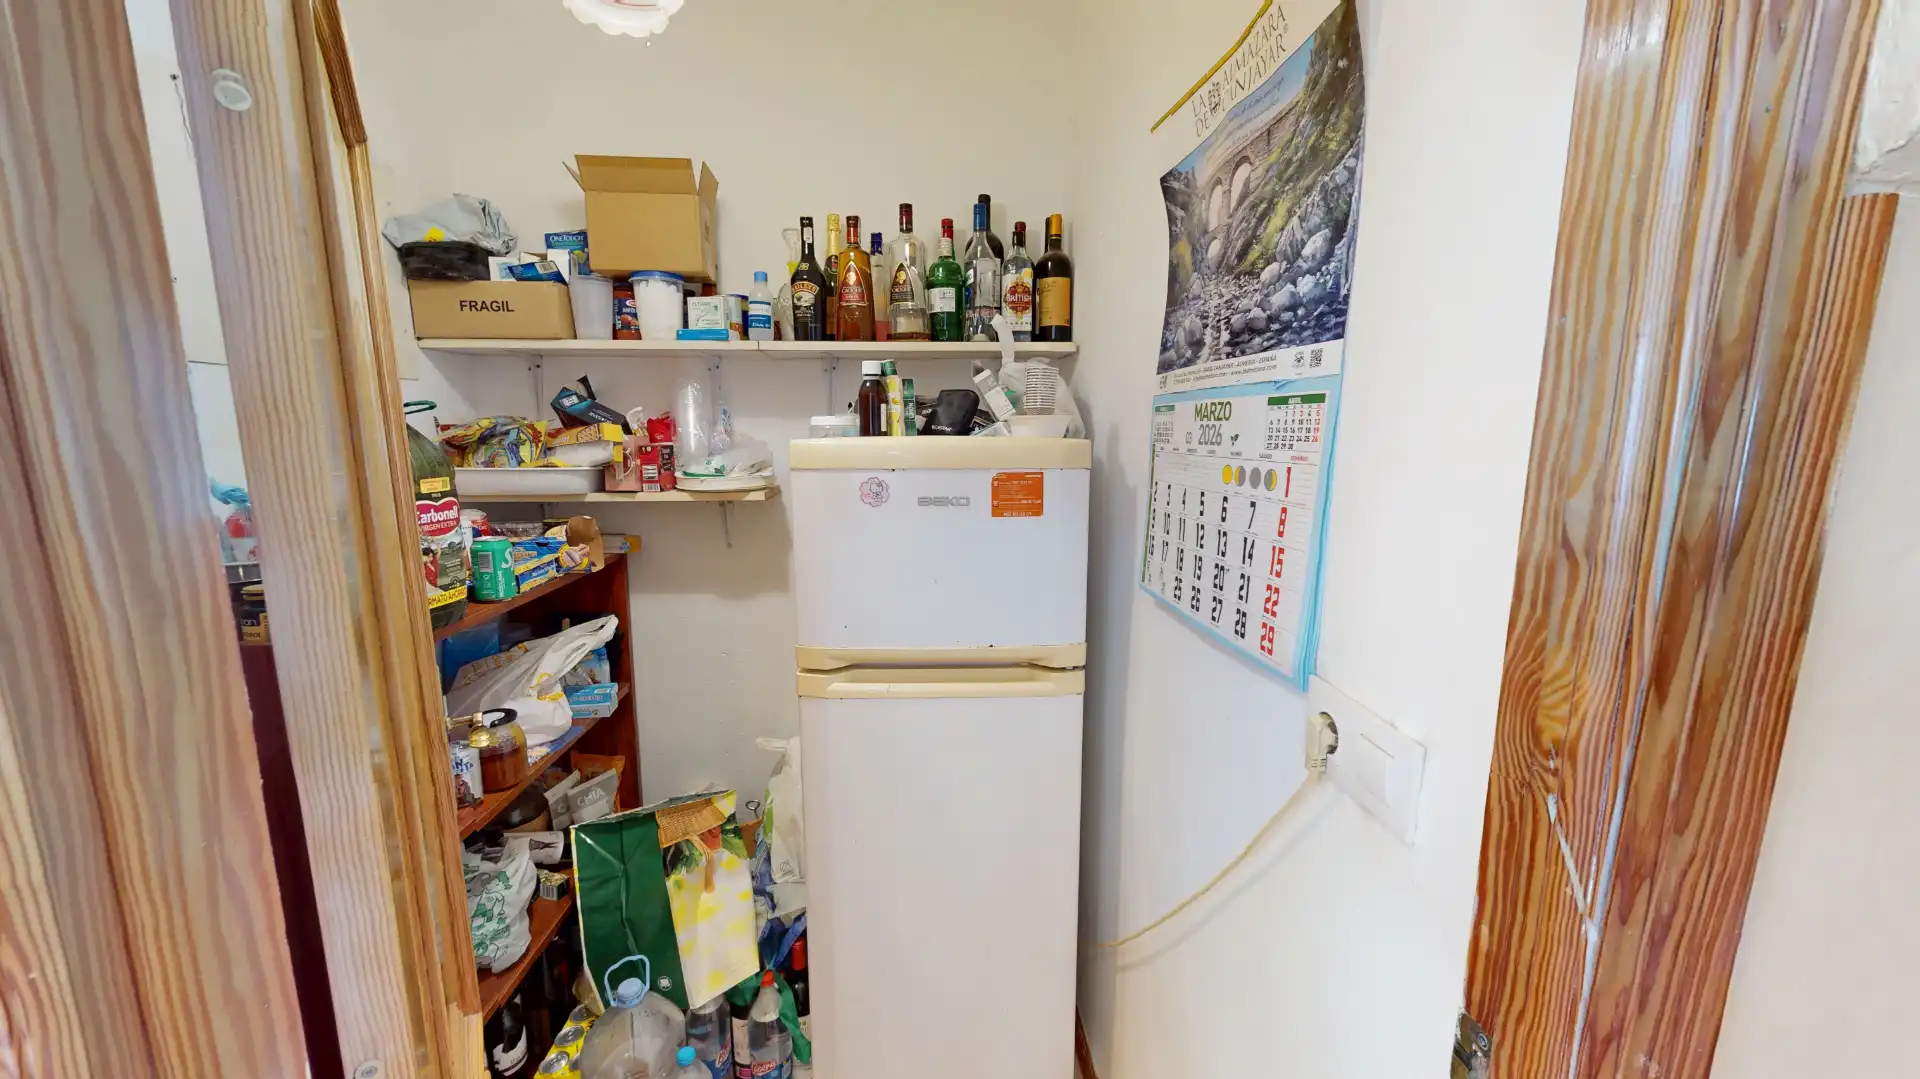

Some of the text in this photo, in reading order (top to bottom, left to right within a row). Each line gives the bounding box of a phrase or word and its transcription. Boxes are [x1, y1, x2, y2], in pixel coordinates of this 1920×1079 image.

[1191, 93, 1206, 117] LA
[1222, 5, 1286, 91] ALMAZARA
[1195, 111, 1210, 138] DE
[459, 300, 514, 313] FRAGIL
[1194, 401, 1232, 422] MARZO
[1198, 423, 1223, 446] 2026
[1284, 466, 1292, 498] 1
[917, 496, 971, 507] BEKO
[1153, 480, 1288, 537] 2 3 4 5 6 7 8
[440, 520, 457, 529] EXTRA
[1164, 511, 1171, 535] 10
[1178, 517, 1186, 542] 11
[1196, 522, 1205, 549] 12
[1216, 529, 1228, 557] 13
[1242, 536, 1255, 567] 14
[1269, 545, 1285, 579] 15
[1161, 539, 1169, 562] 17
[1176, 546, 1184, 572] 18
[1193, 554, 1203, 581] 19
[1213, 562, 1226, 592] 20
[1238, 572, 1251, 604] 21
[1263, 583, 1281, 618] 22
[1173, 575, 1183, 601] 25
[1190, 585, 1201, 613] 26
[1211, 595, 1223, 624] 27
[1234, 607, 1248, 640] 28
[1260, 621, 1276, 656] 29
